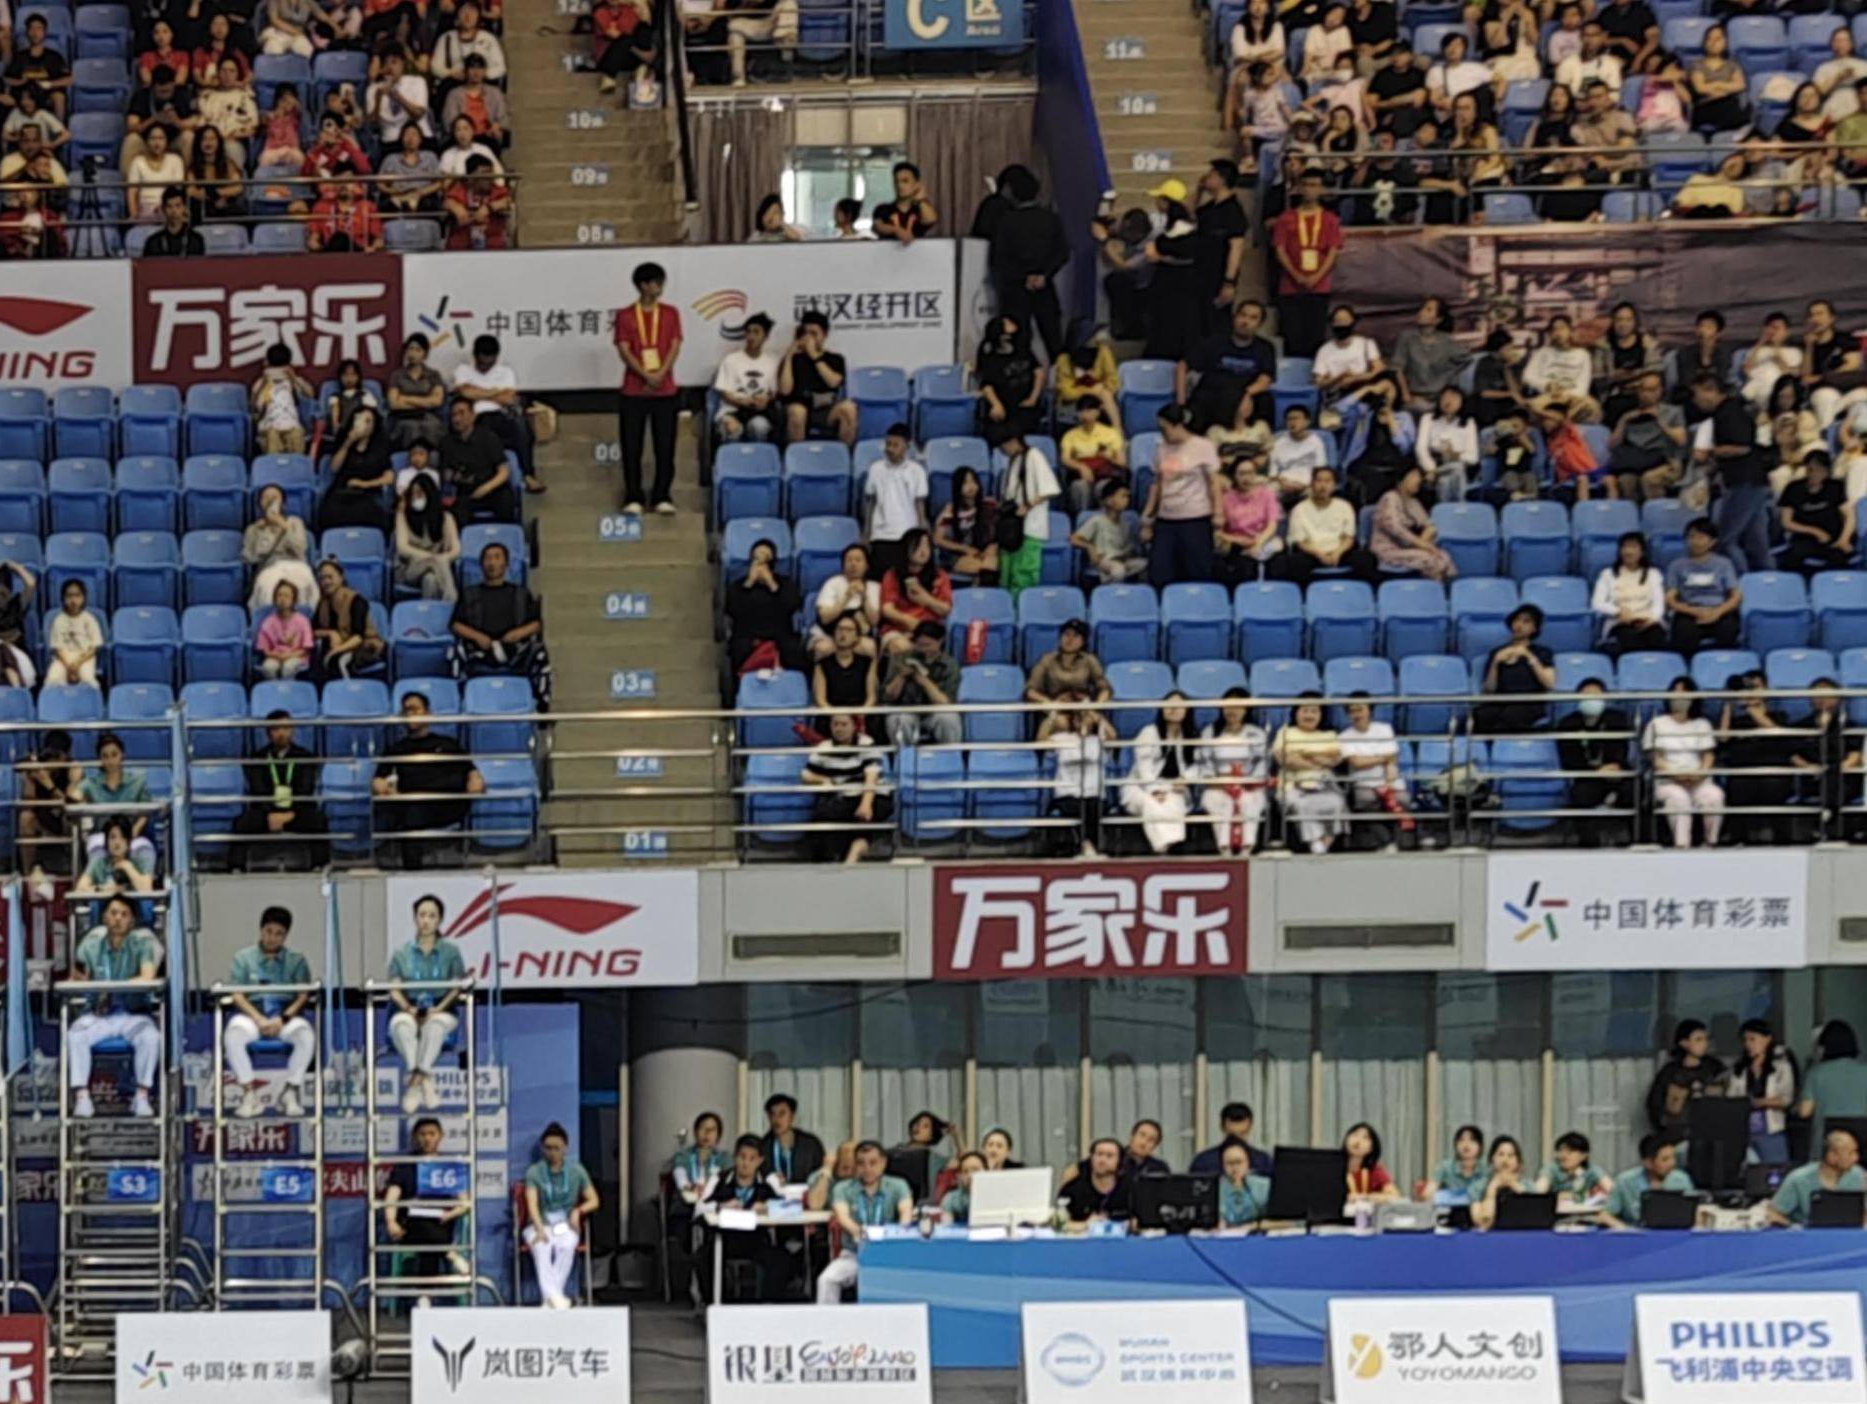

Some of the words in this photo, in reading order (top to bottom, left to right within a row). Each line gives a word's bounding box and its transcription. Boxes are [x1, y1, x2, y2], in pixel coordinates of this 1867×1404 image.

[149, 281, 388, 371] 万家乐
[950, 872, 1231, 969] 万家乐
[1582, 895, 1792, 931] 中国体育彩票
[467, 948, 642, 978] I-NING
[119, 1176, 147, 1195] S3
[274, 1176, 301, 1195] E5
[429, 1168, 457, 1187] E6
[1388, 1330, 1544, 1362] 鄂人文创
[1670, 1320, 1832, 1351] PHILIPS
[182, 1358, 317, 1383] 中国体育彩票
[483, 1347, 610, 1378] 岚图汽车
[1397, 1365, 1538, 1382] YOYOMANGO
[1656, 1355, 1854, 1385] 飞利浦中央空调
